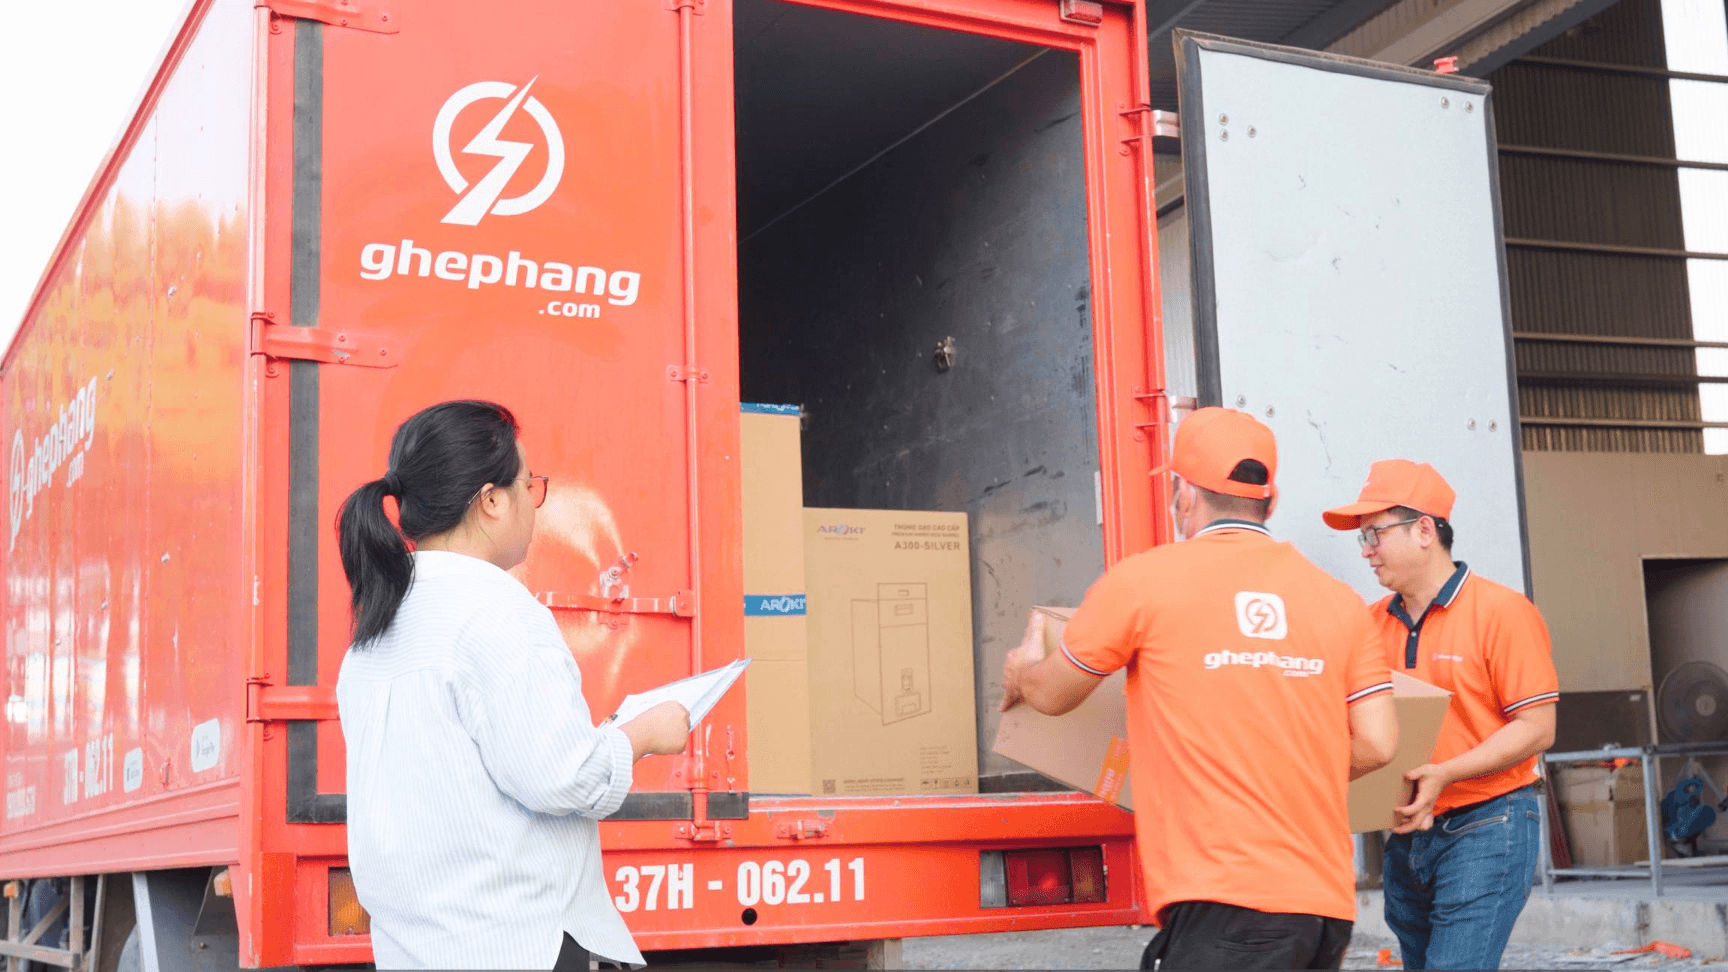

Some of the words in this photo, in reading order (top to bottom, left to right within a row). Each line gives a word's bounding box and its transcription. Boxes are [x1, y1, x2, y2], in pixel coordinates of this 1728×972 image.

[360, 239, 641, 306] ghephang
[538, 301, 601, 318] .com
[26, 375, 98, 520] ghephang
[894, 541, 960, 550] A300-SILVER
[1204, 649, 1325, 675] ghephang
[615, 863, 694, 912] 37H
[737, 857, 865, 906] 062.11
